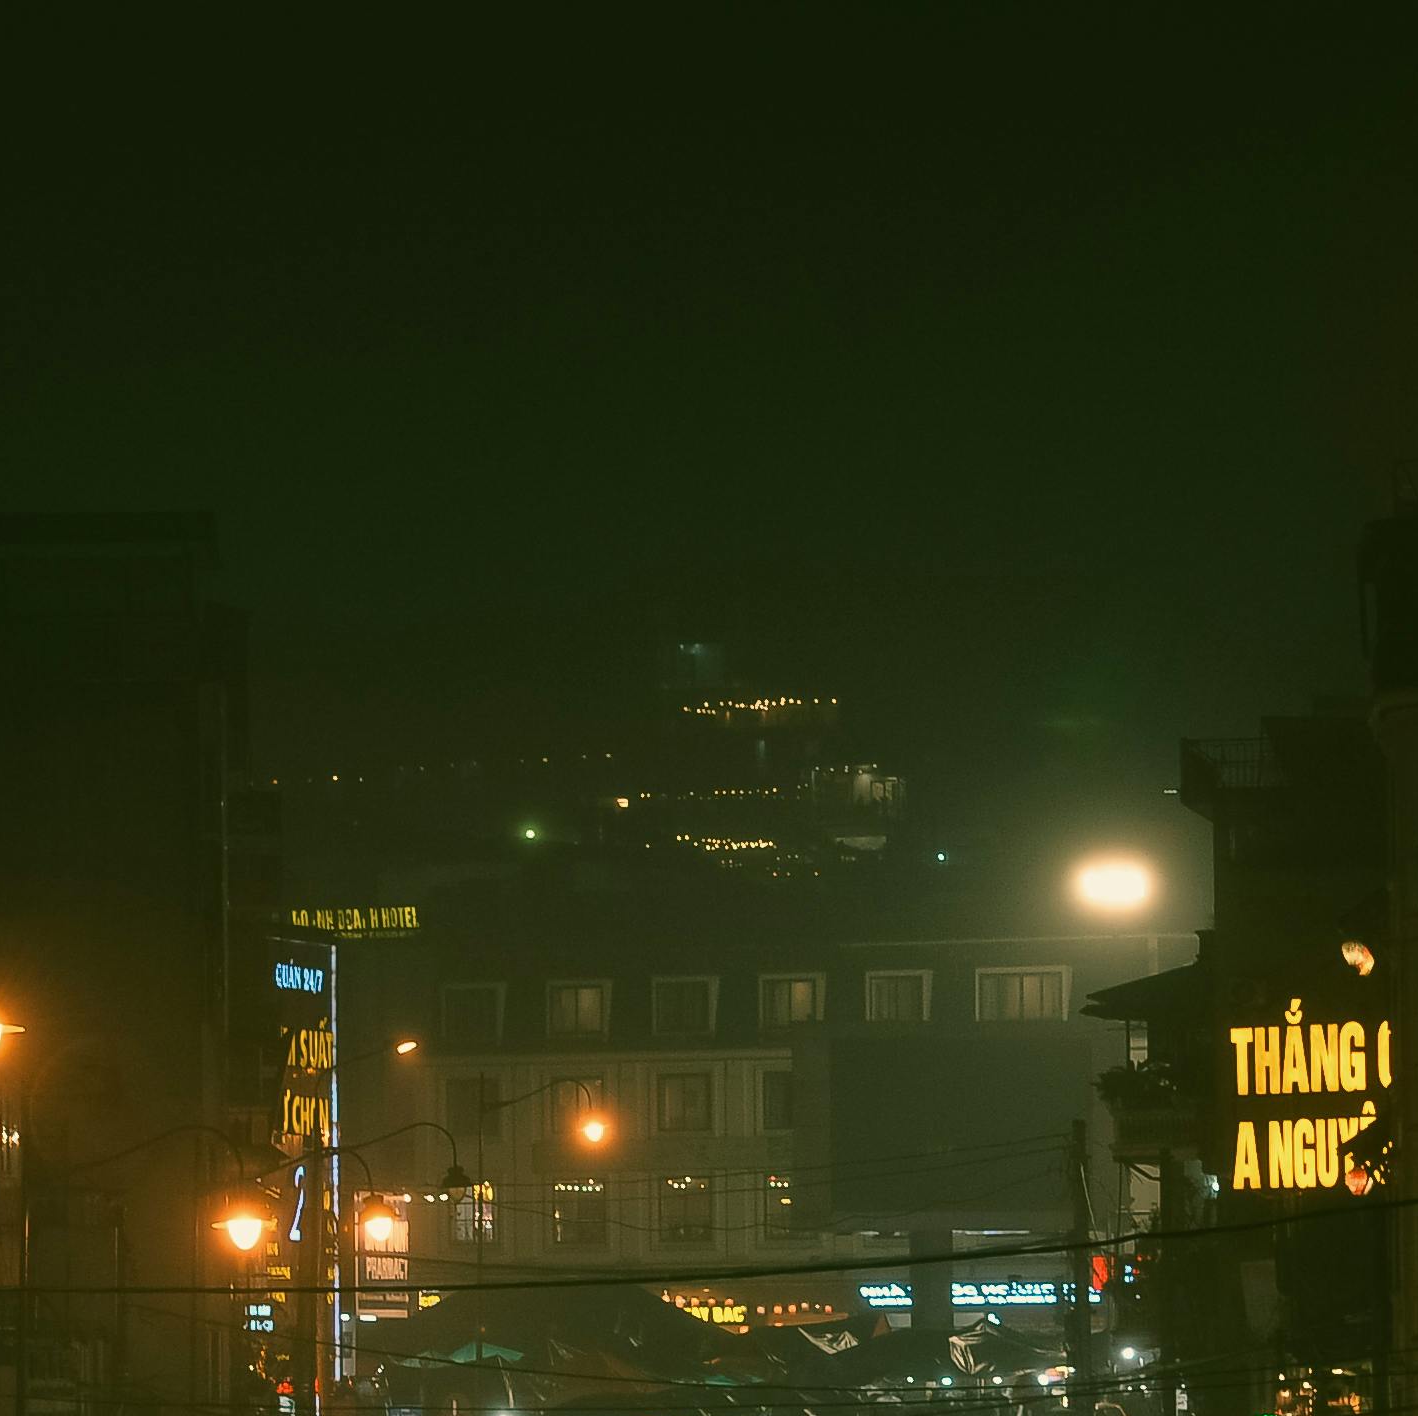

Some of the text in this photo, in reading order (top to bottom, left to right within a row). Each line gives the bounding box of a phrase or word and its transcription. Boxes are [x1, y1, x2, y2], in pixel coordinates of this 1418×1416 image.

[382, 906, 419, 929] HOTEL
[1230, 997, 1367, 1096] THẮNG
[1232, 1121, 1262, 1191] A
